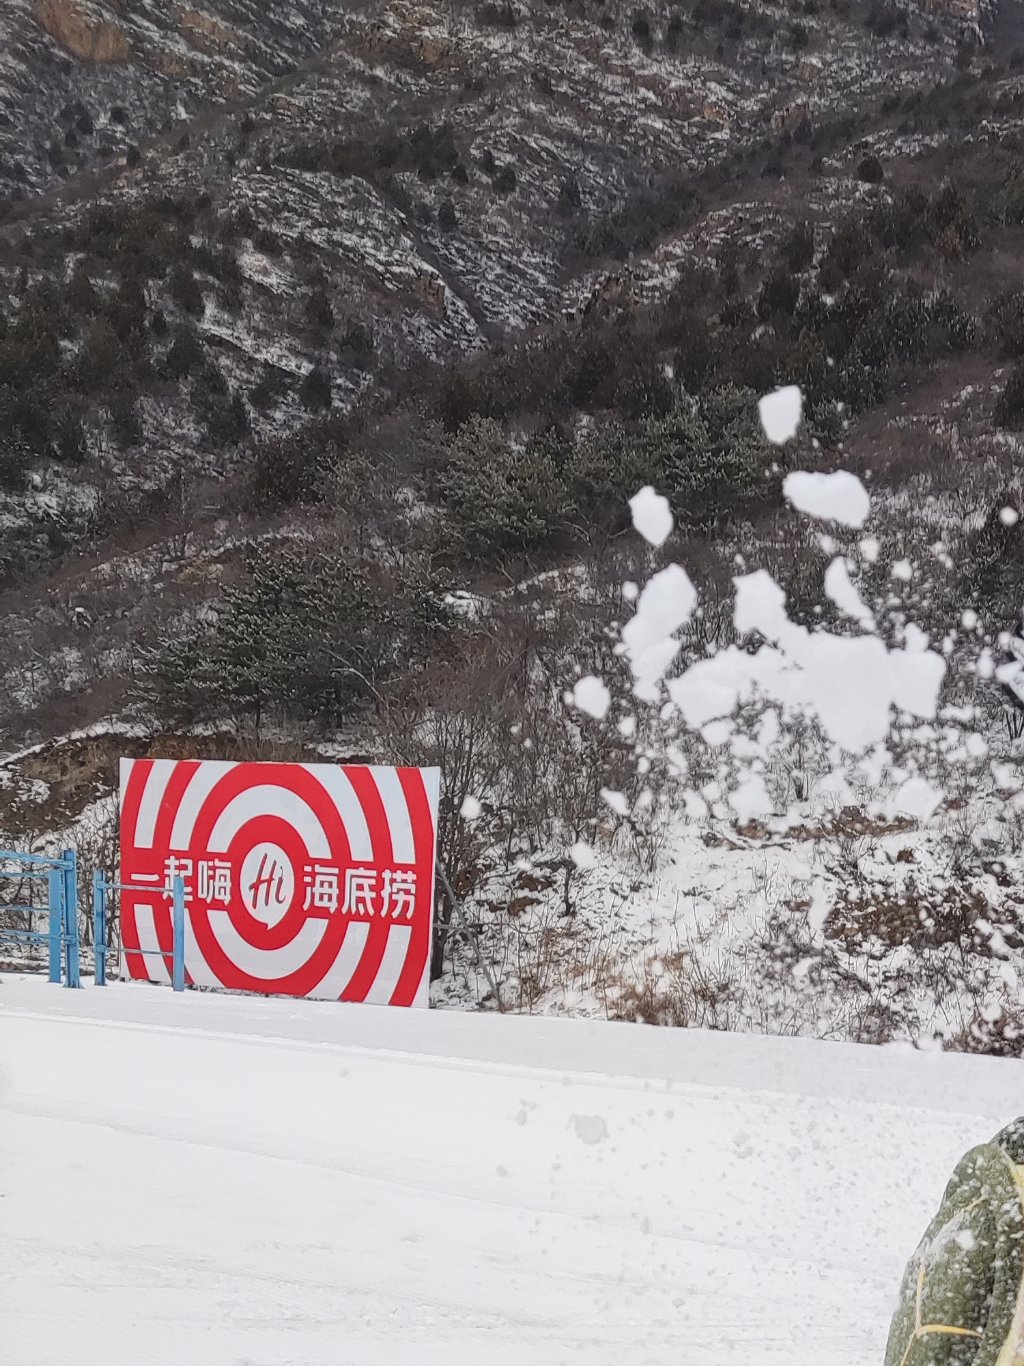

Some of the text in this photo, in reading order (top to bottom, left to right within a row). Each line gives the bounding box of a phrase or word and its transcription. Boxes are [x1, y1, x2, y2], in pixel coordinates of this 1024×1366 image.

[131, 855, 232, 905] 一起嗨
[249, 853, 287, 911] Hi
[303, 864, 418, 920] 海底捞
